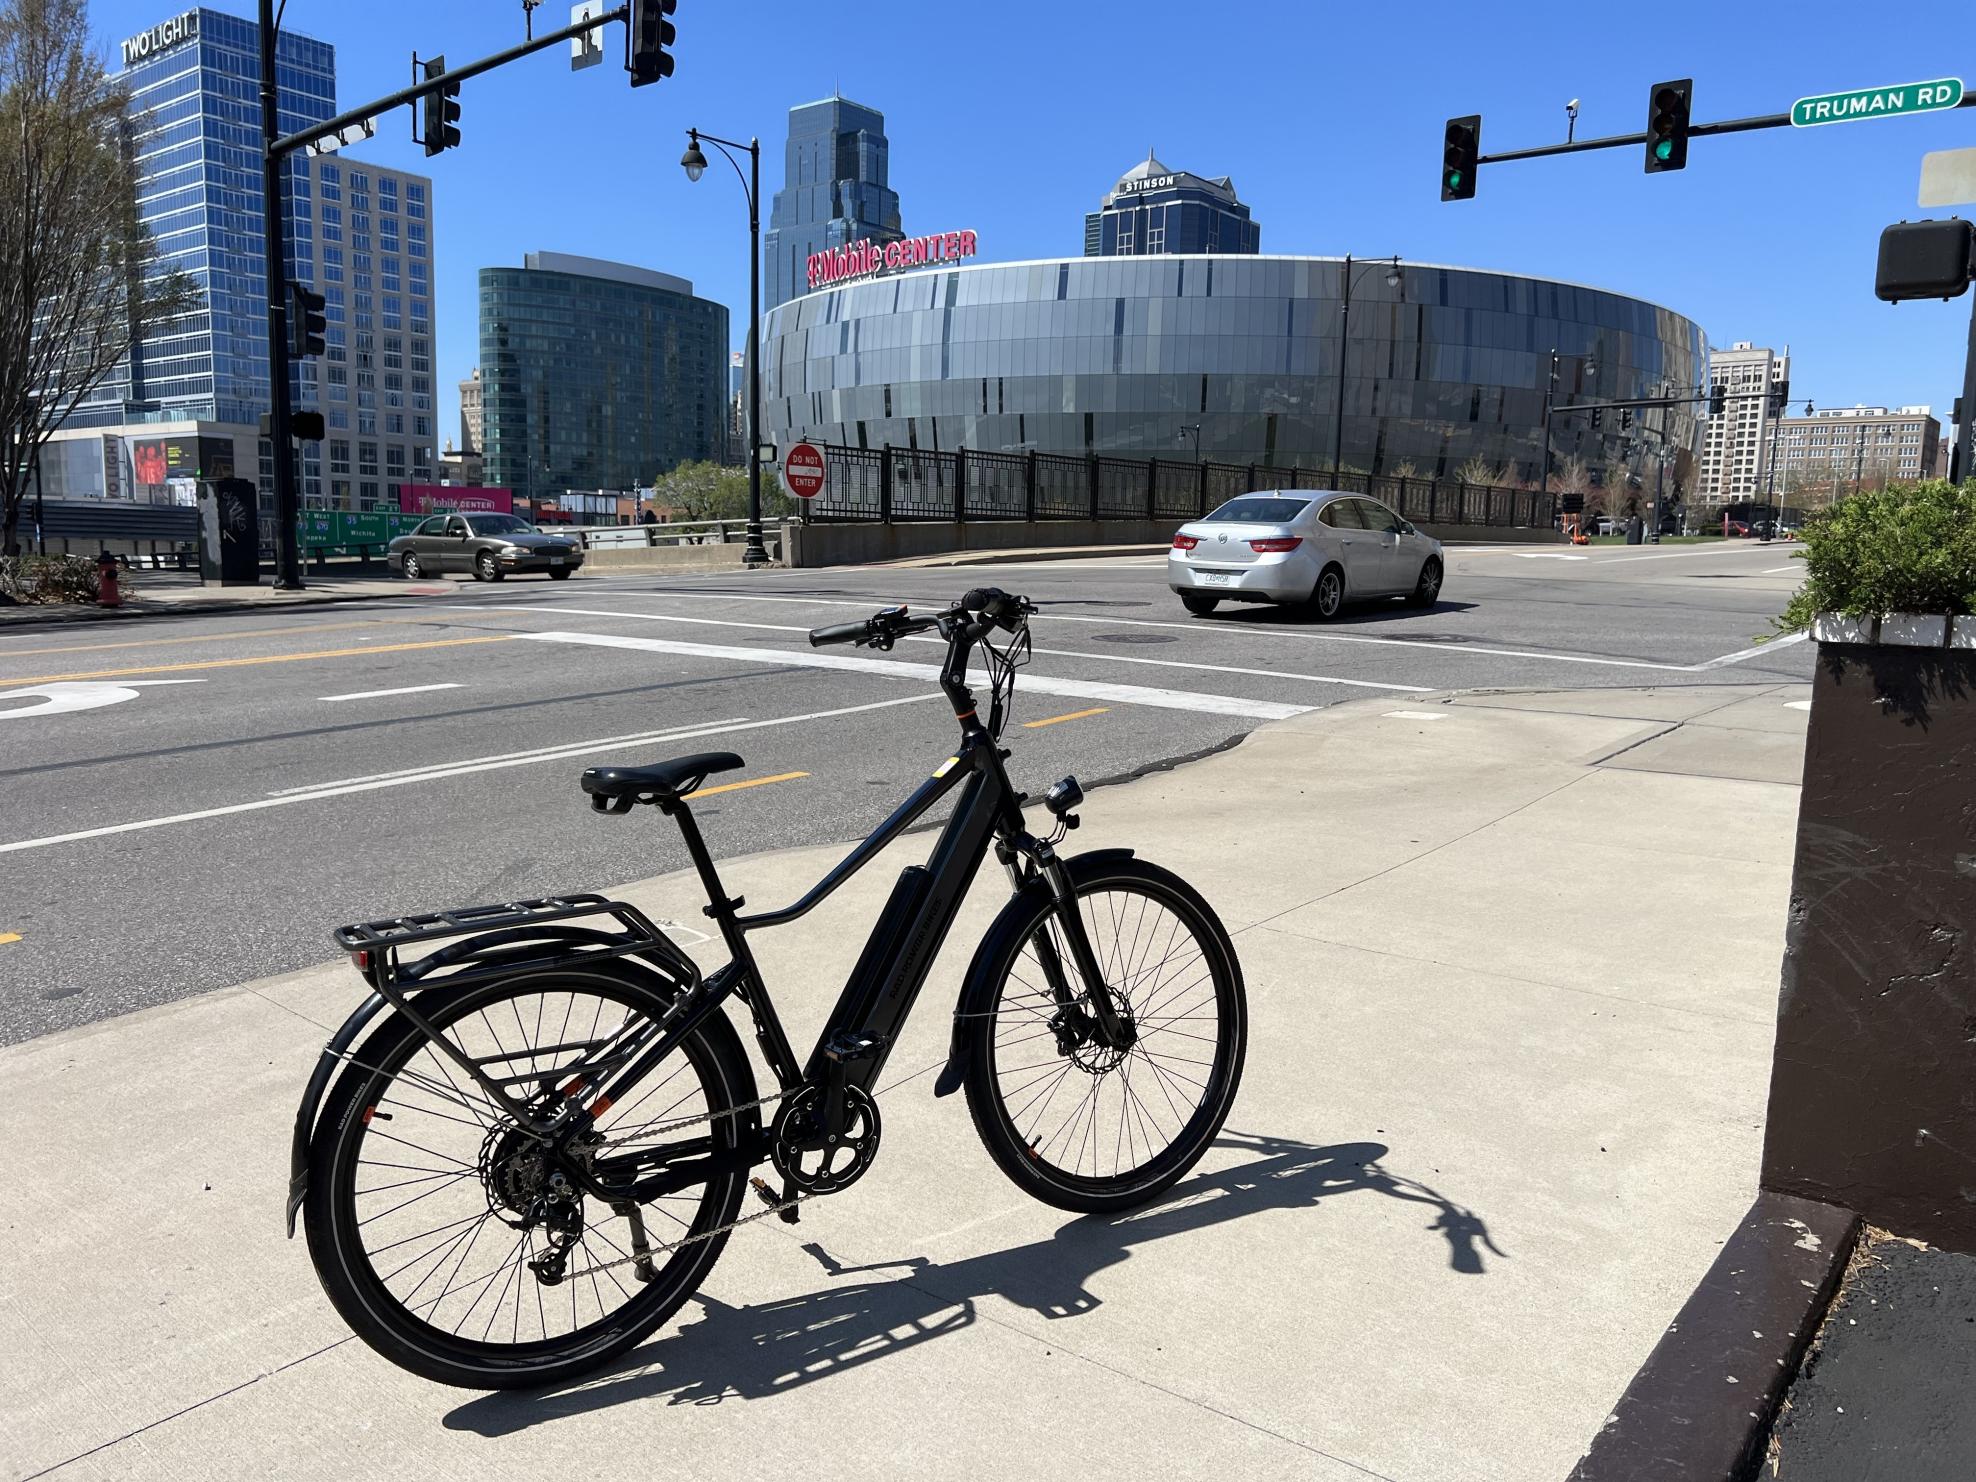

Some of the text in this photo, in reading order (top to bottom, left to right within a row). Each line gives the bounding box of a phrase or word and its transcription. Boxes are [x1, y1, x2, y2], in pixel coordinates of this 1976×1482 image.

[121, 13, 190, 63] TWO LIGHT
[1802, 85, 1952, 120] TRUMAN RD
[1126, 175, 1174, 192] STINSON
[885, 230, 977, 269] CENTER
[105, 437, 119, 477] LIGHT
[793, 455, 818, 464] DO NOT
[795, 478, 816, 487] ENTER
[460, 500, 493, 509] CENTER
